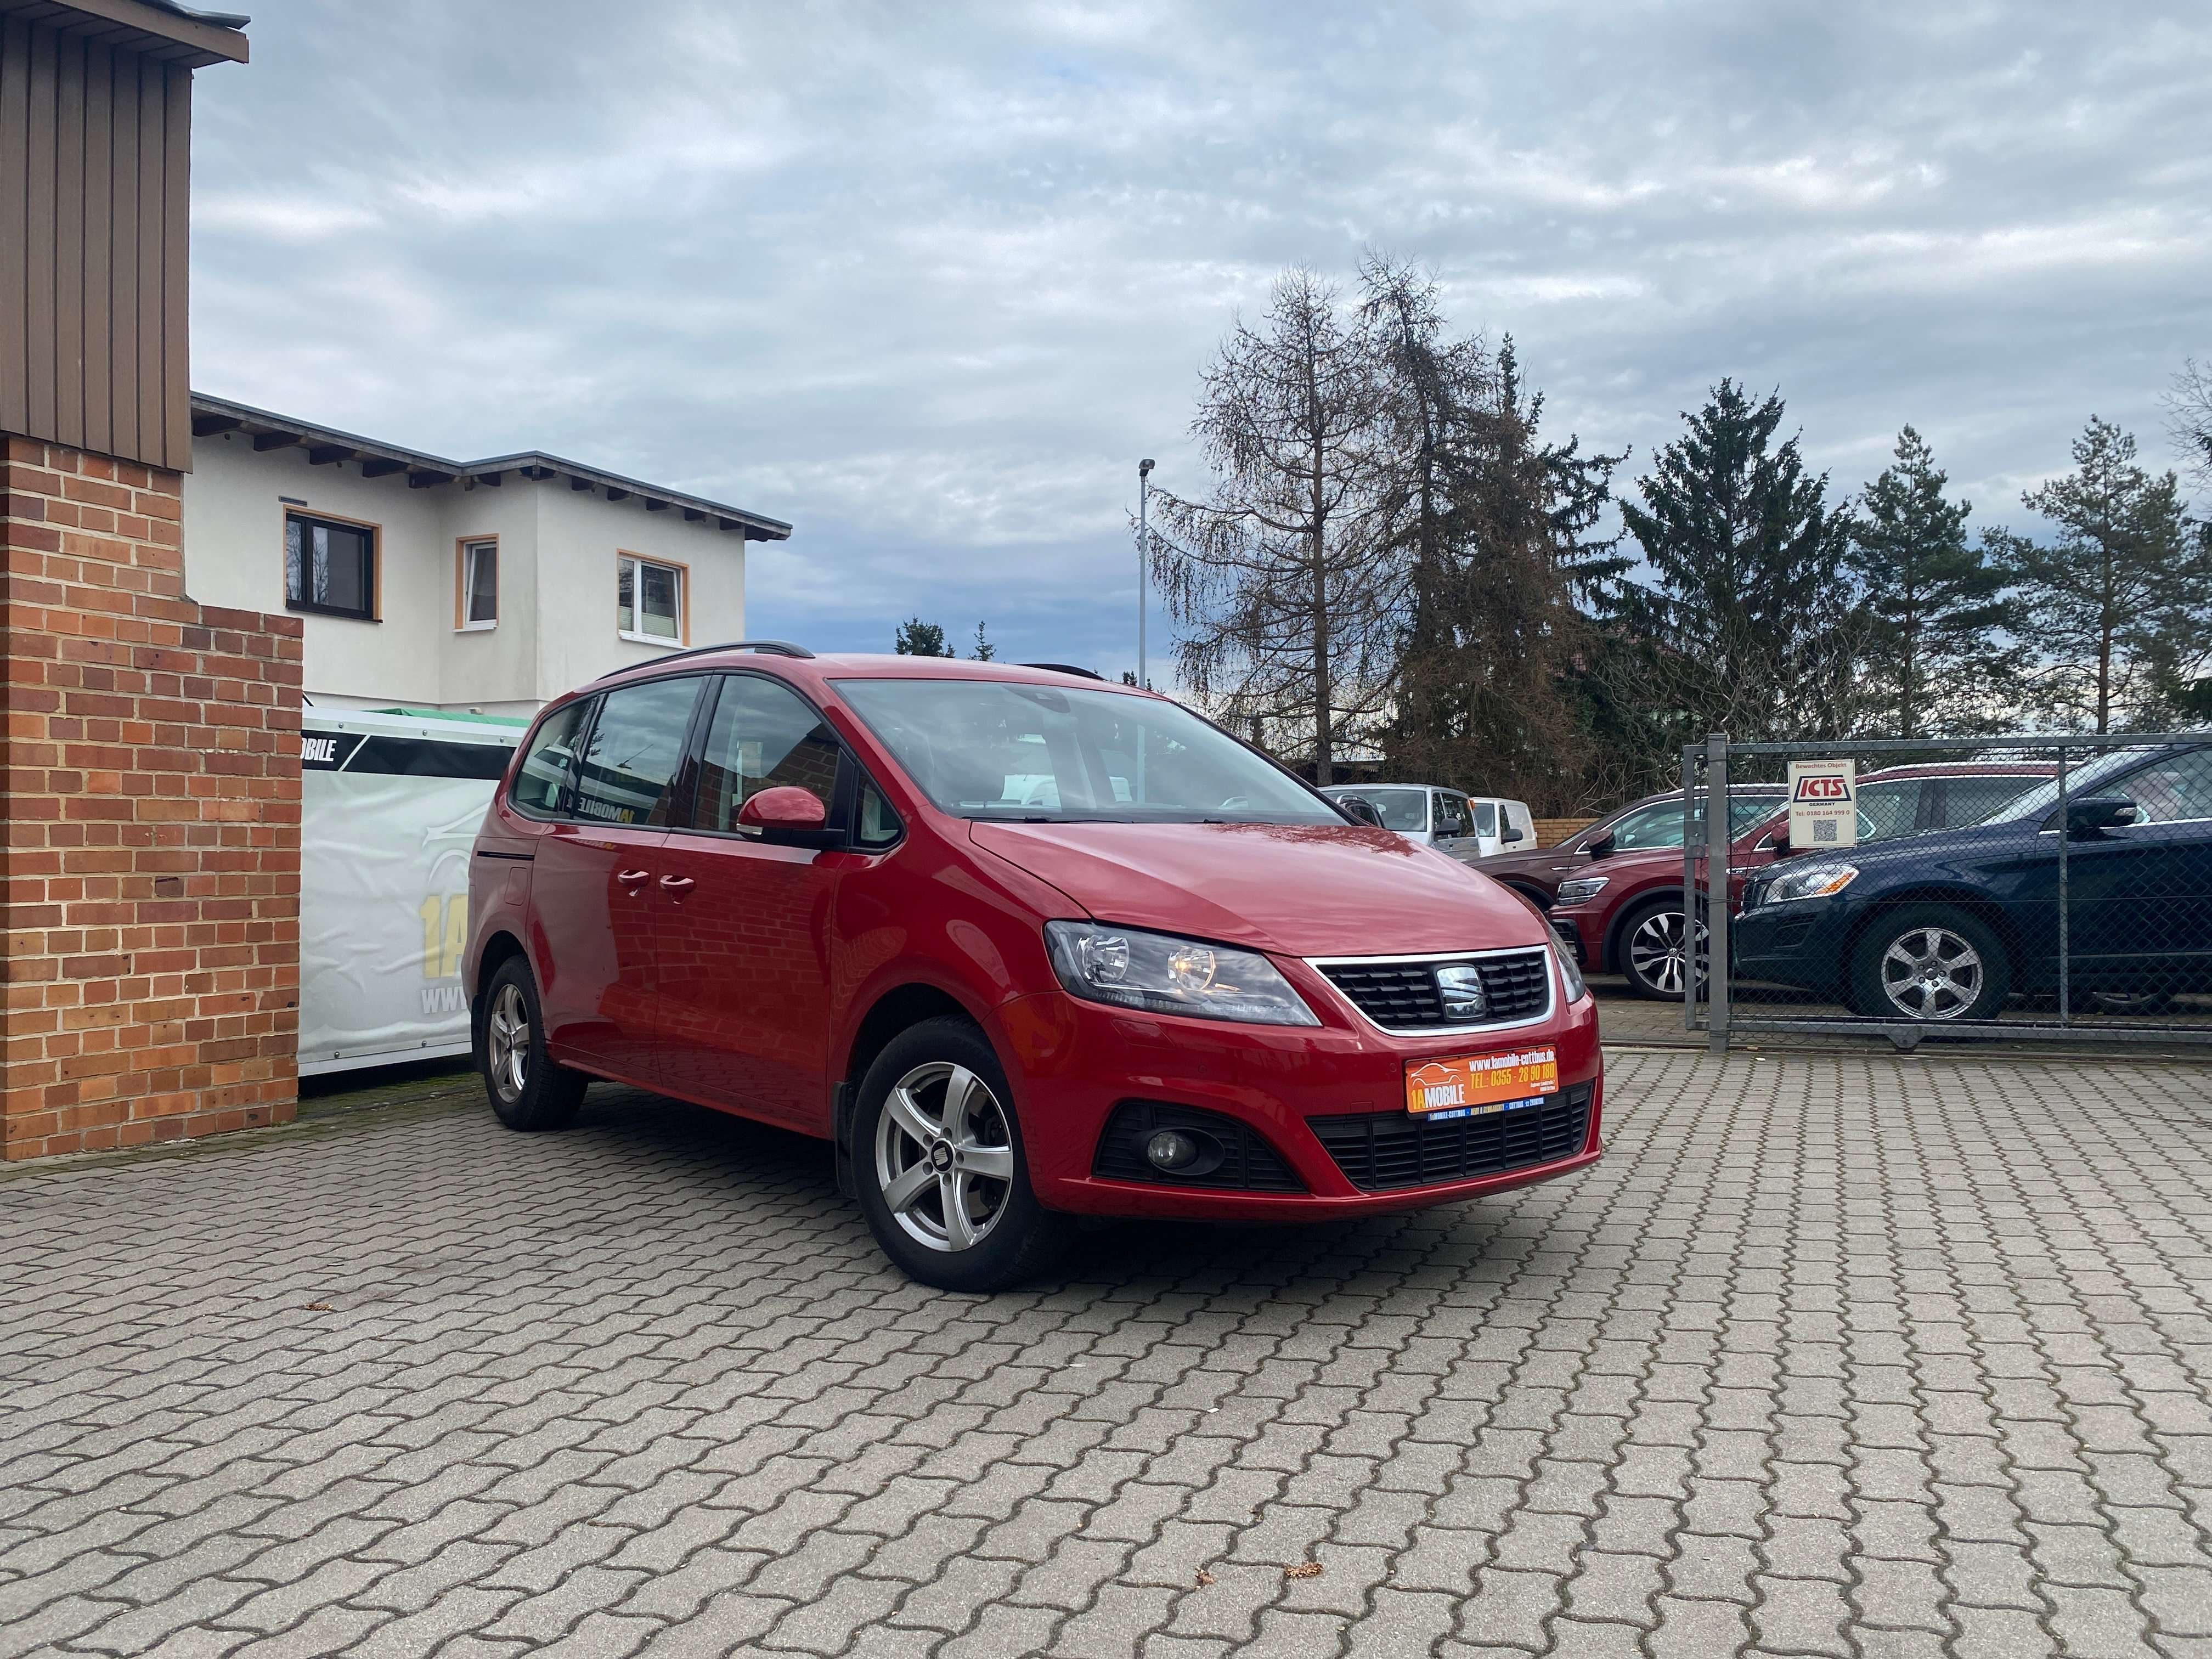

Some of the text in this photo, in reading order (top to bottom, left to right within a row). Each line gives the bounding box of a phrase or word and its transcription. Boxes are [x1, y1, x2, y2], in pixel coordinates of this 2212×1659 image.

[1800, 778, 1846, 797] ICTS
[1469, 1049, 1555, 1072] www.1amobile-cottbus.de
[1491, 1069, 1512, 1087] 0355
[1519, 1066, 1529, 1083] 28
[1531, 1064, 1541, 1081] 90
[1542, 1063, 1555, 1079] 180
[1412, 1084, 1465, 1110] 1AMOBILE
